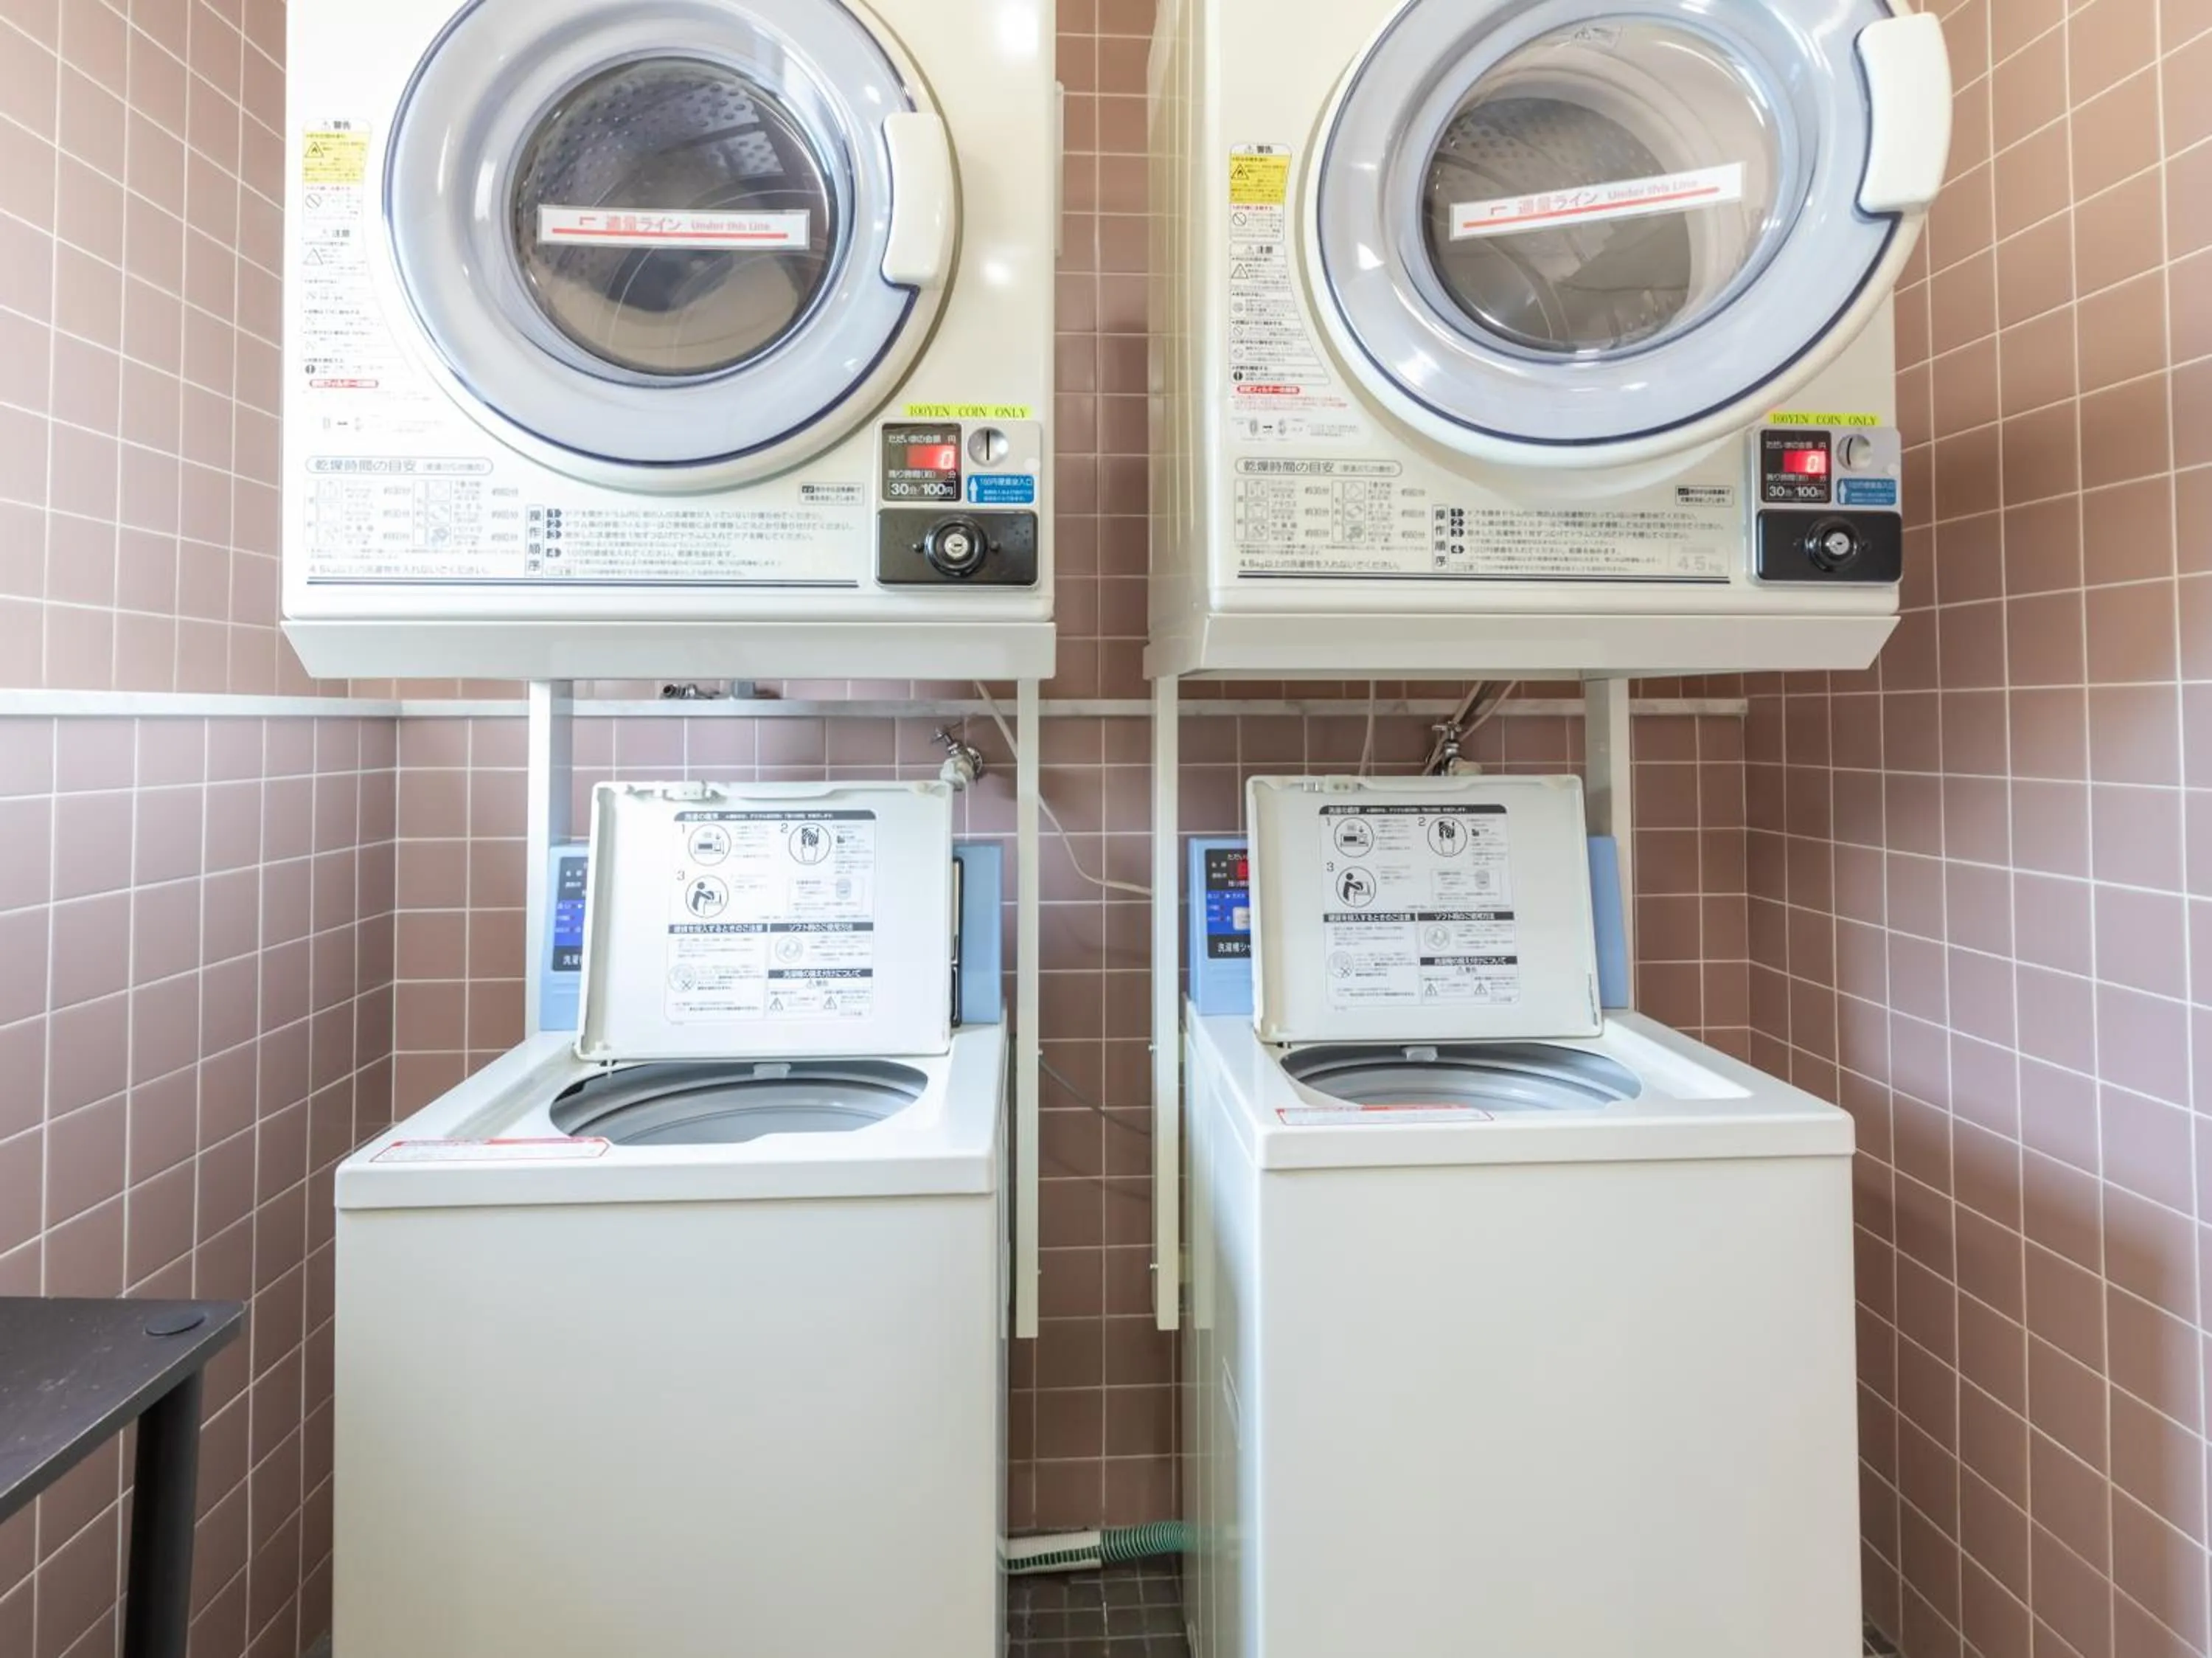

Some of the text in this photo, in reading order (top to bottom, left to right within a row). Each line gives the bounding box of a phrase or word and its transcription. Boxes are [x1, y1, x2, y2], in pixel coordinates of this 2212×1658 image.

[1607, 186, 1644, 201] Under
[1647, 183, 1669, 196] this
[691, 221, 771, 231] Under this Line
[910, 406, 1027, 418] 100YEN COIN ONLY
[1773, 414, 1877, 426] 100YEN COIN ONLY
[947, 434, 956, 443] 円
[940, 451, 953, 469] 0
[1807, 454, 1819, 473] 0
